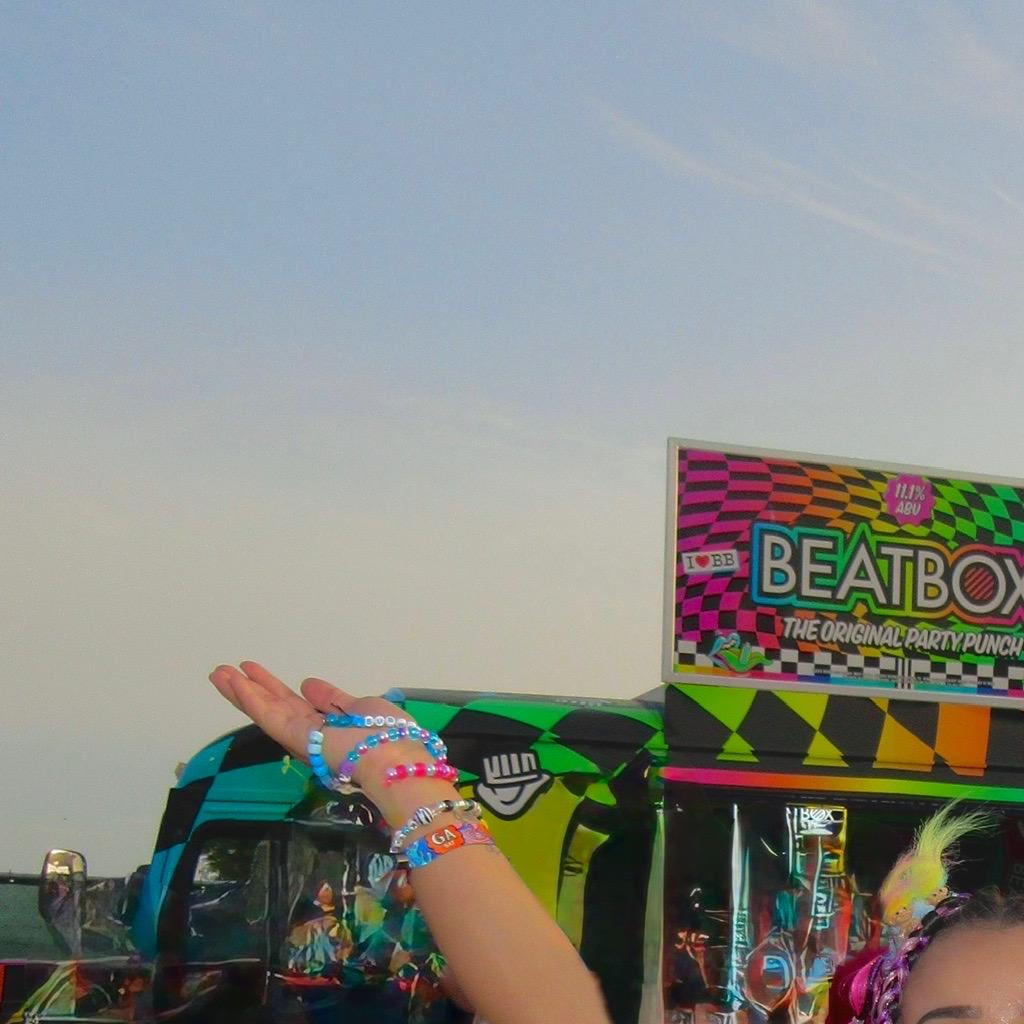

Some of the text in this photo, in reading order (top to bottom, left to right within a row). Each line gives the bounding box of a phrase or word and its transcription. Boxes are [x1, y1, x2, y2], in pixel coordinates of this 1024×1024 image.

[895, 483, 926, 501] 11.1%
[711, 553, 735, 567] BB
[783, 617, 1024, 656] THE ORIGINAL PARTY PUNCH
[431, 829, 457, 845] GA
